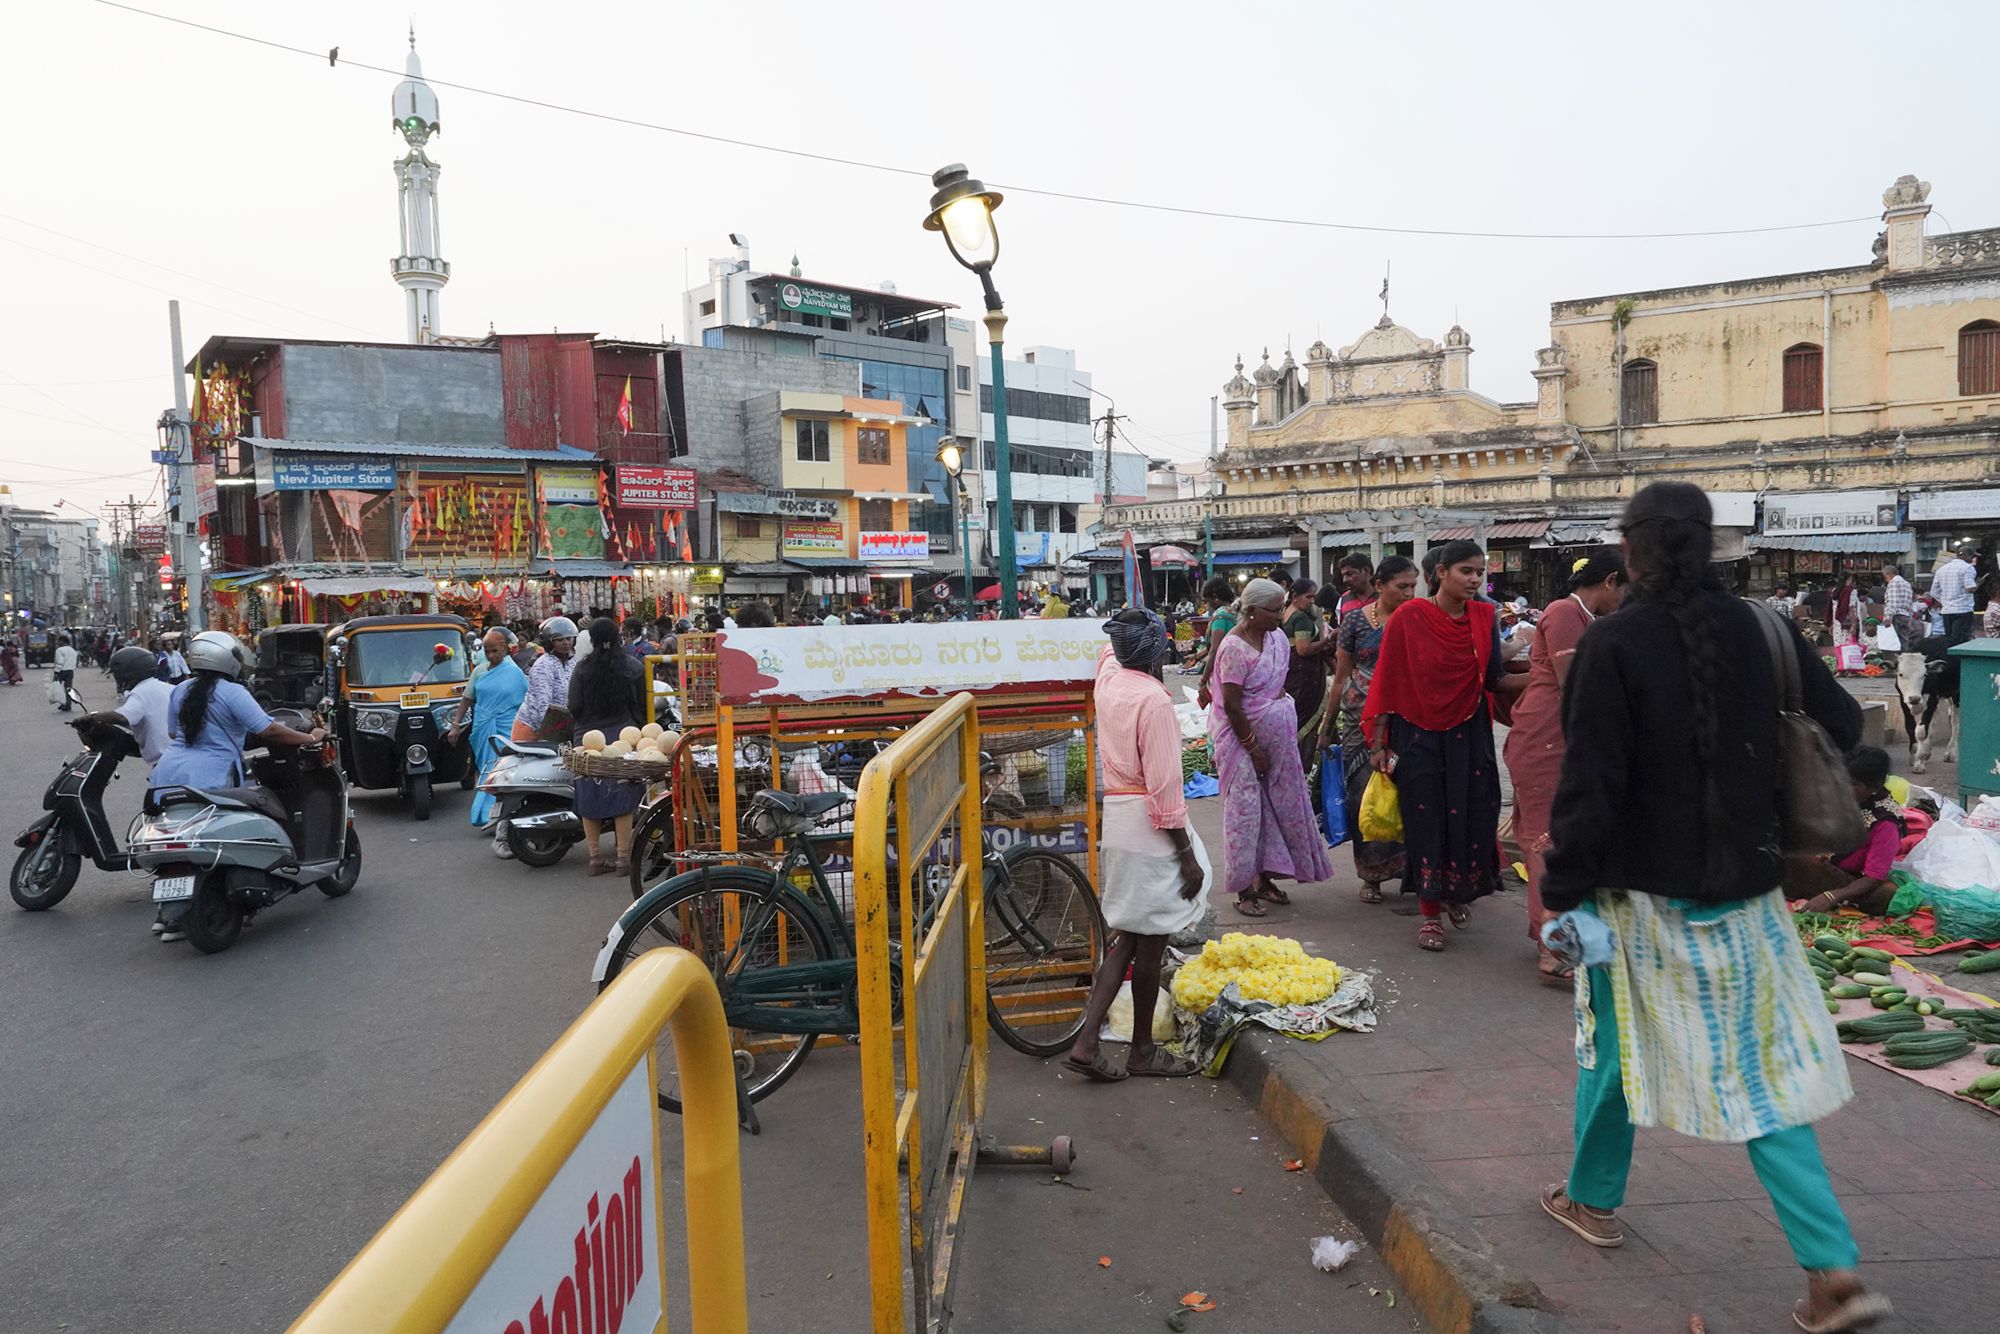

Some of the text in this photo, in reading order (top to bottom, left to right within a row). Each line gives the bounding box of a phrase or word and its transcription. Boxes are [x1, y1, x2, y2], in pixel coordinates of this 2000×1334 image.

[803, 299, 838, 309] NAIVEDYAM
[280, 474, 392, 485] New Jupiter Store
[622, 489, 695, 500] JUPITER STORES
[804, 639, 923, 683] ಮೈಸೂರು
[937, 637, 1002, 664] ನಗರ
[982, 823, 1076, 852] OLICE
[502, 1155, 643, 1334] tion
